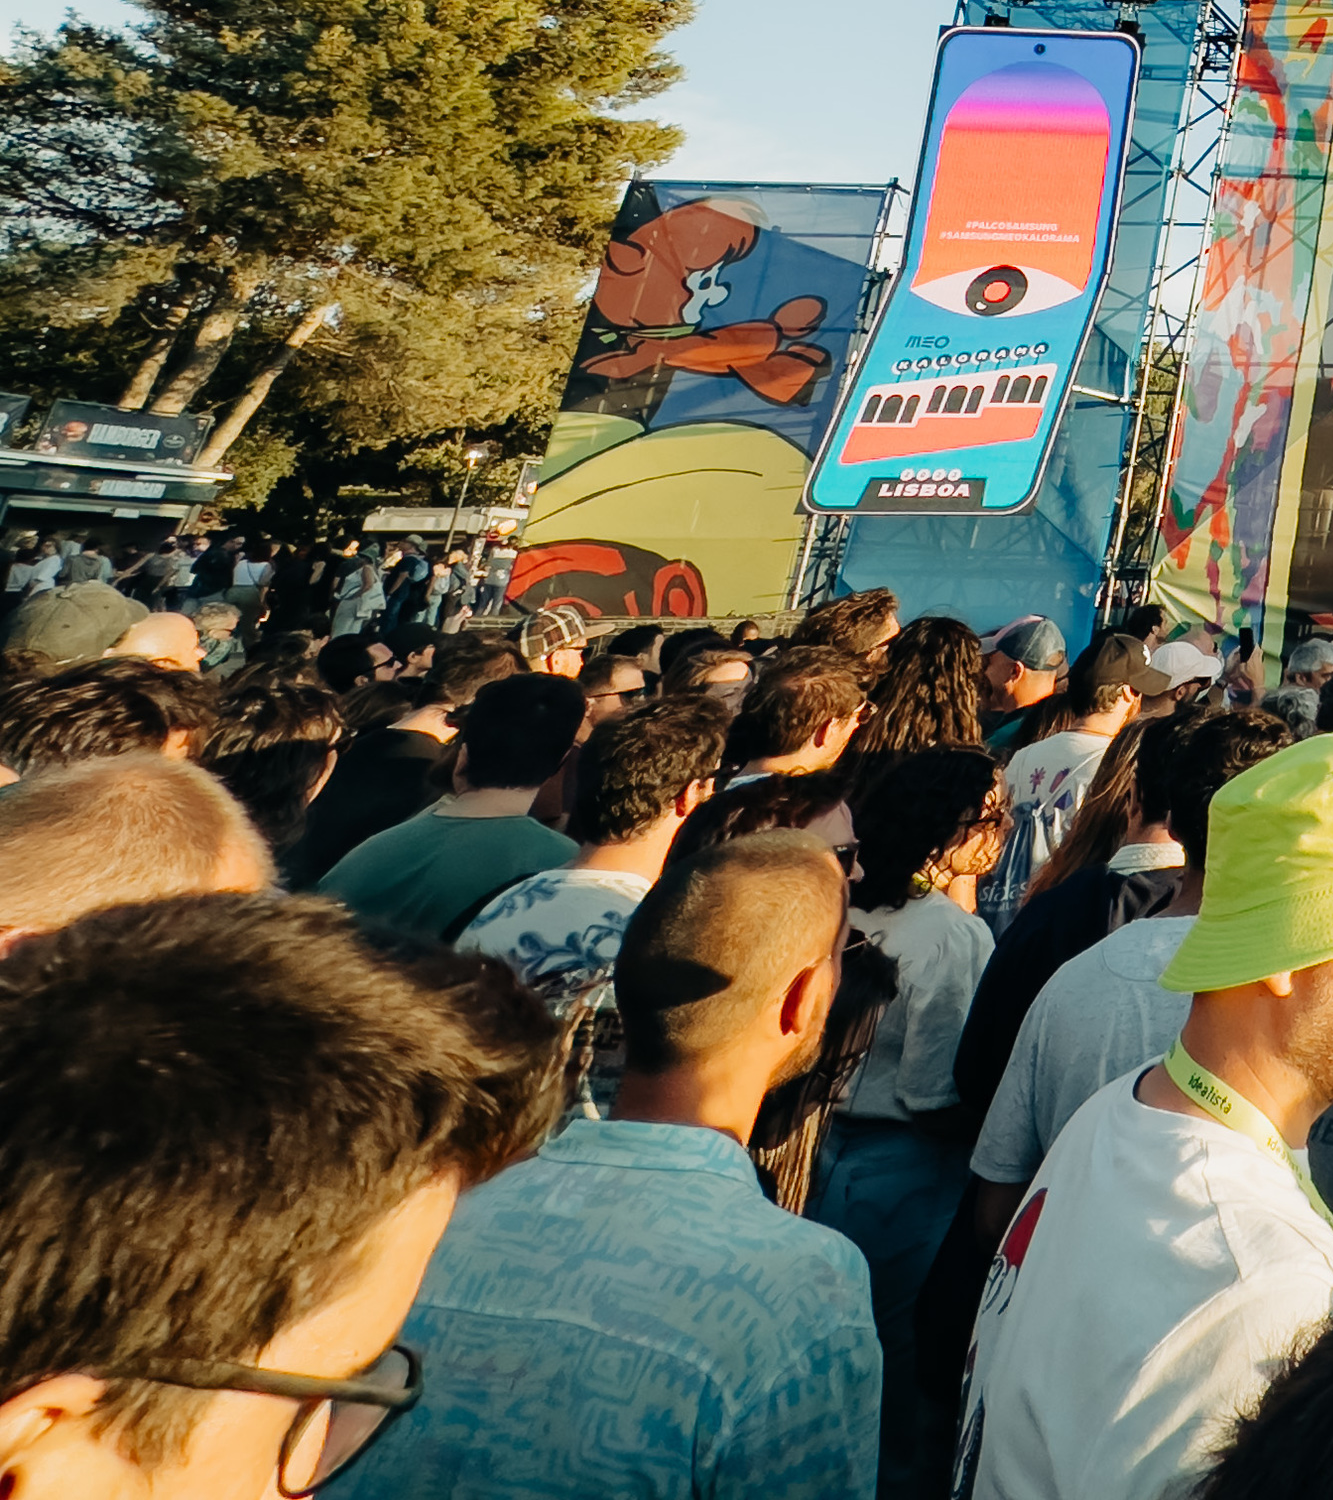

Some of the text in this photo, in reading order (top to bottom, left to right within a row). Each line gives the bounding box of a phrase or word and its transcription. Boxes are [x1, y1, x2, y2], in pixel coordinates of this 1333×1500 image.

[904, 335, 950, 349] MEO
[896, 341, 1050, 373] KALORAMA
[877, 483, 971, 498] LISBOA
[1188, 1072, 1233, 1115] idealista
